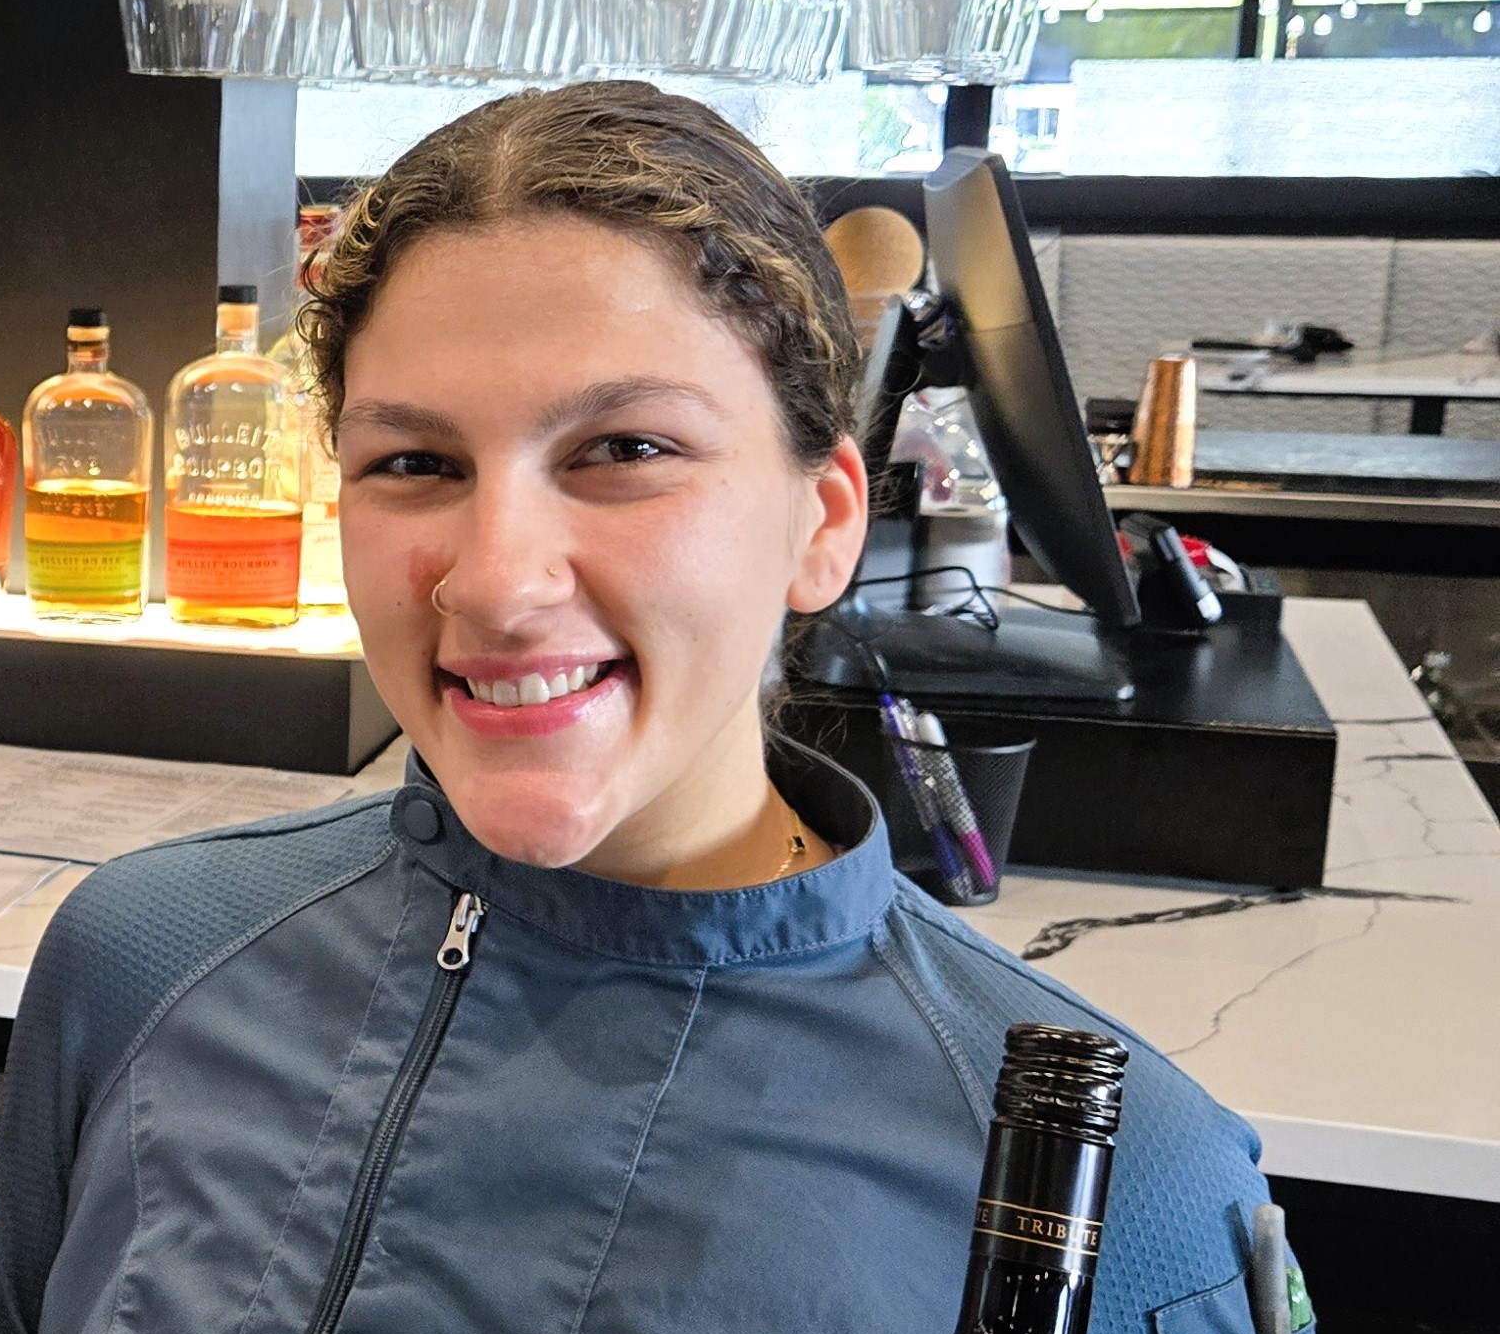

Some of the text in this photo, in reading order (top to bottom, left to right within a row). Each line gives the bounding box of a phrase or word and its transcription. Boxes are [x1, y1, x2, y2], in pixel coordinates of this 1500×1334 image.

[176, 559, 278, 569] BULLEIT BOURBON
[1016, 1214, 1099, 1247] TRIBUTE
